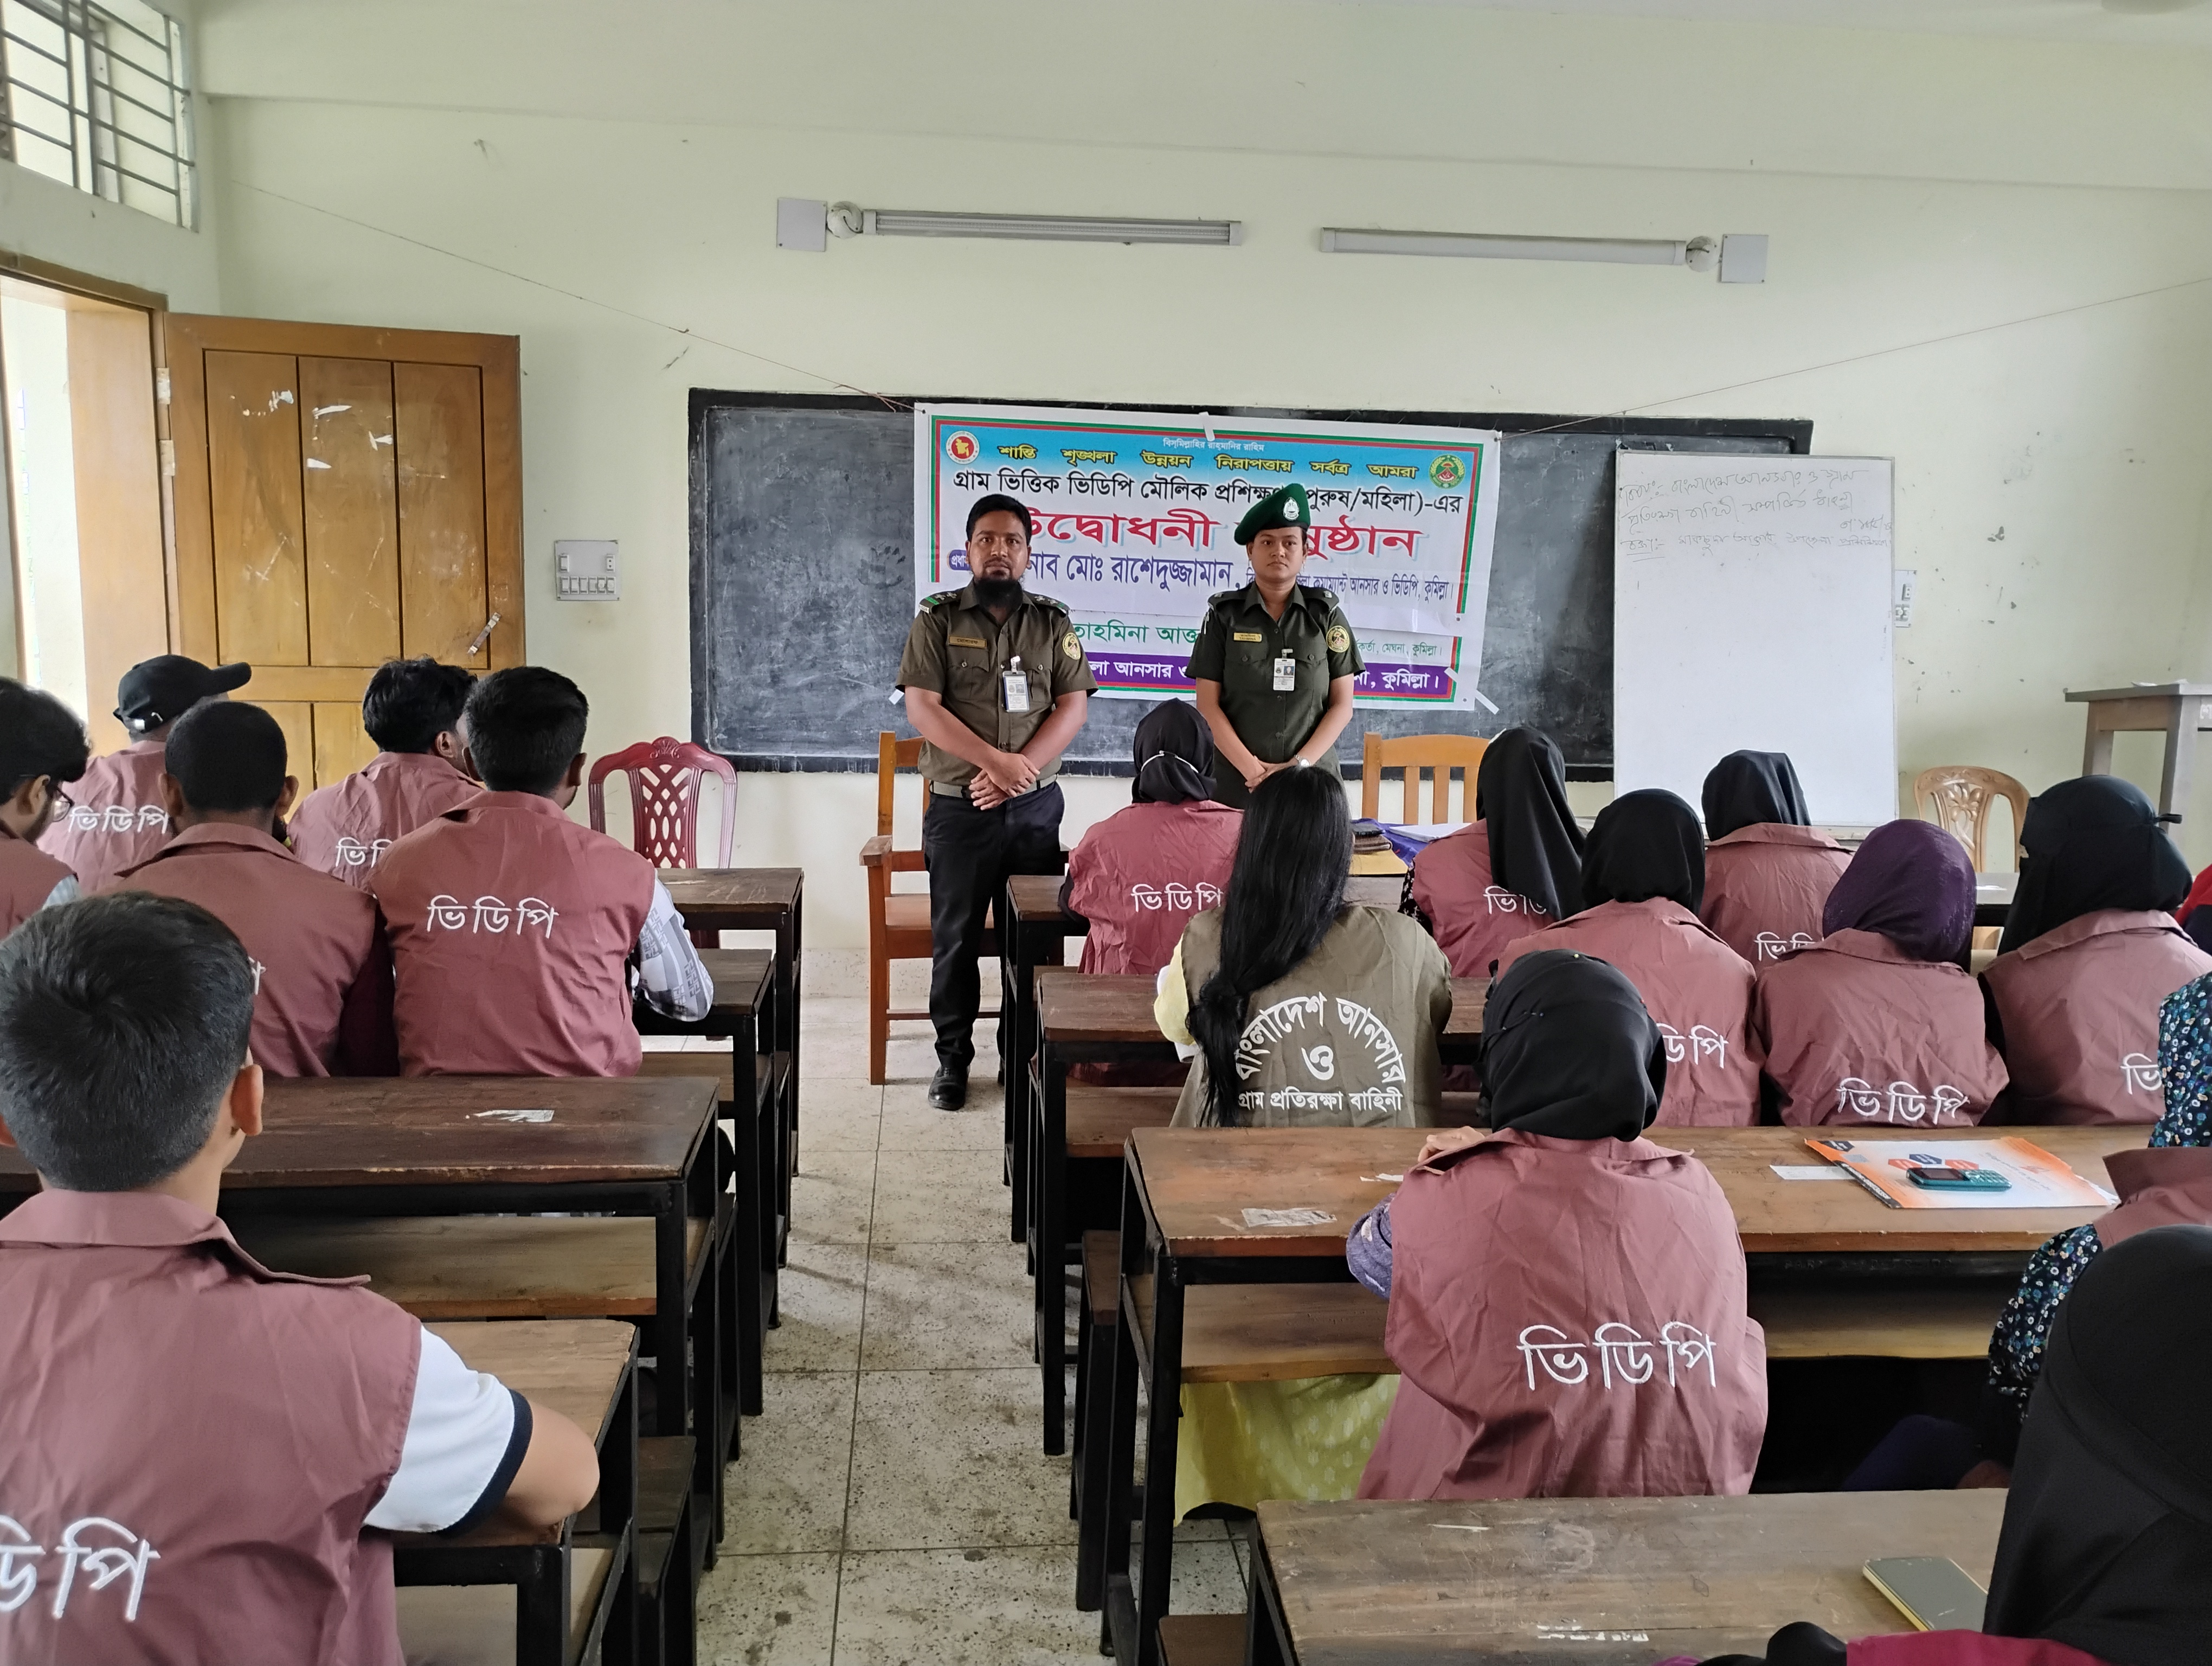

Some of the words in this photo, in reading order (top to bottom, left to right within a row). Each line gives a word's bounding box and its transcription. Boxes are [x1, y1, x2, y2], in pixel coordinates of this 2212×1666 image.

[1244, 442, 1264, 451] রাহিম
[998, 444, 1038, 459] শান্তি
[1060, 449, 1118, 466] শৃঙ্খলা
[1140, 450, 1194, 469] উন্নয়ন
[1214, 454, 1295, 473] নিরাপত্তায়
[1309, 459, 1351, 475] সর্বত্র
[1366, 465, 1419, 479] আমরা
[954, 470, 992, 491] গ্রাম
[996, 467, 1061, 494] ভিত্তিক
[1066, 471, 1135, 497] ভিডিপি
[1141, 473, 1209, 501] মৌলিক
[1067, 553, 1103, 582] মোঃ
[1350, 576, 1380, 595] আনসার
[1113, 661, 1174, 678] আনসার
[1234, 991, 1327, 1080] বাংলাদেশ
[1336, 997, 1406, 1084] আনসার
[1302, 1046, 1334, 1080] ও
[1239, 1091, 1264, 1111] গ্রাম
[1270, 1086, 1343, 1111] প্রতিরক্ষা
[1348, 1086, 1403, 1112] বাহিনী
